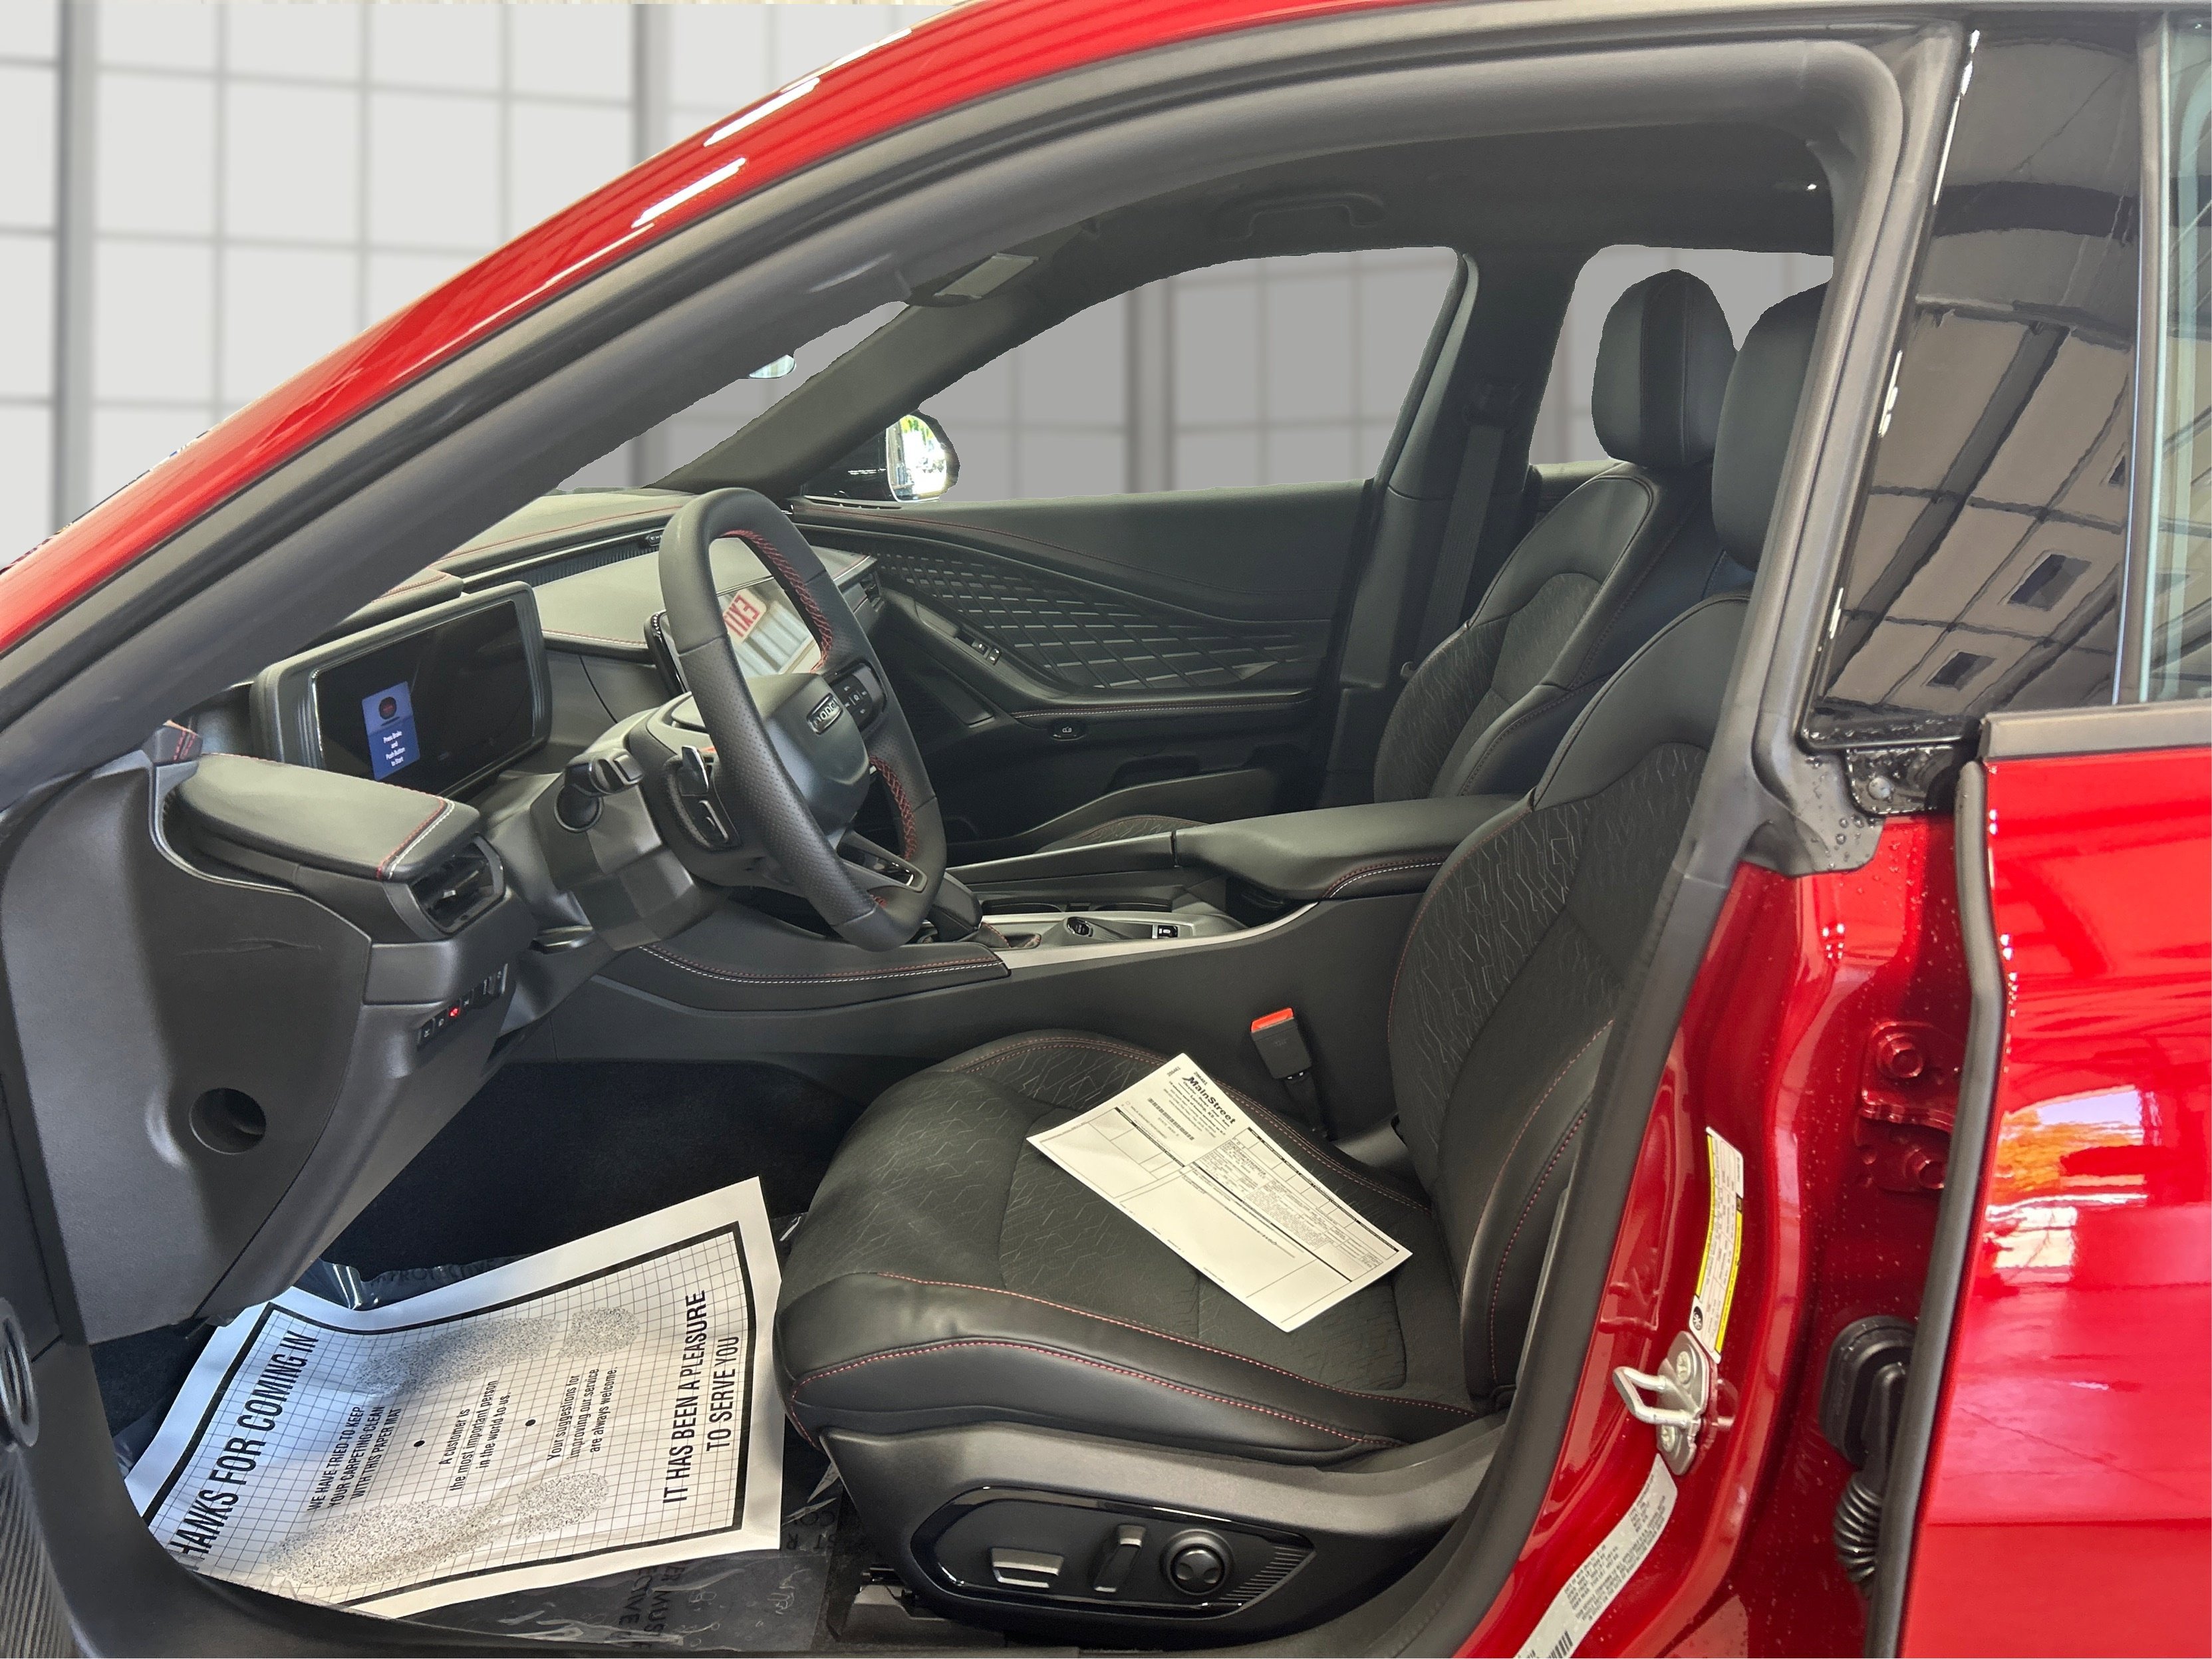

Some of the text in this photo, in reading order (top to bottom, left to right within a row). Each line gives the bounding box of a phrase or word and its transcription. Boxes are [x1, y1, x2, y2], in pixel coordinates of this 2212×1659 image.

[386, 747, 406, 760] Push Button
[1188, 1077, 1236, 1124] MainStreet
[444, 1420, 466, 1457] customer
[457, 1408, 470, 1418] is
[449, 1380, 498, 1491] the most important person
[487, 1418, 503, 1442] world
[493, 1407, 507, 1417] to
[547, 1375, 580, 1461] Your suggestions for
[567, 1368, 599, 1460] improving our service
[590, 1366, 618, 1453] are always welcome.
[663, 1289, 707, 1503] IT HAS BEEN A PLEASURE
[706, 1336, 740, 1452] TO SERVE YOU
[170, 1330, 319, 1560] HANKS FOR COMING IN
[307, 1406, 365, 1511] WE HAVE TRIED TO KEEP
[327, 1406, 385, 1508] YOUR CARPETING CLEAN
[350, 1408, 402, 1499] WITH THIS PAPER MAT
[476, 1459, 491, 1469] in
[480, 1443, 495, 1458] the
